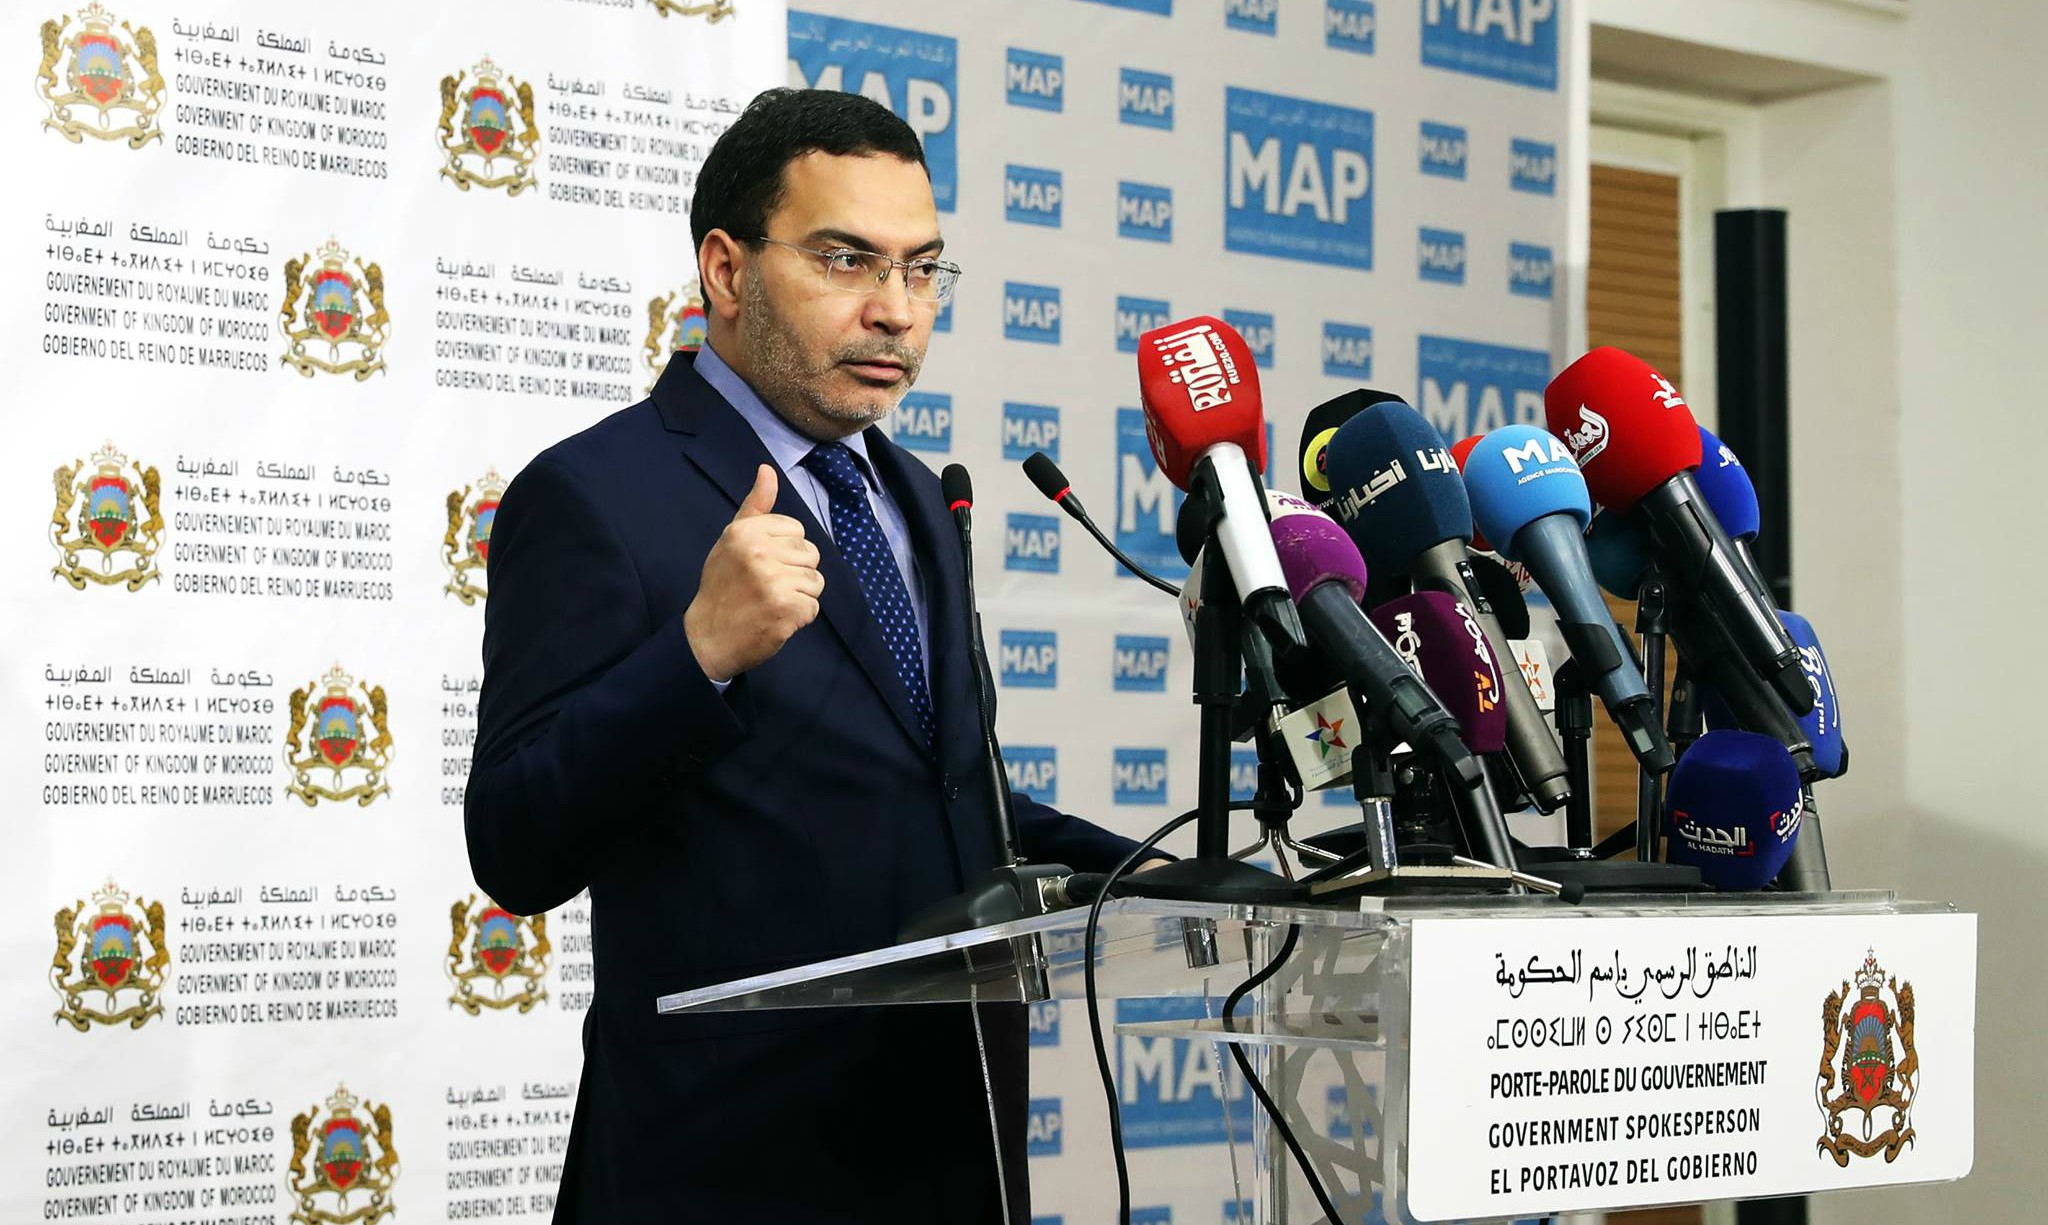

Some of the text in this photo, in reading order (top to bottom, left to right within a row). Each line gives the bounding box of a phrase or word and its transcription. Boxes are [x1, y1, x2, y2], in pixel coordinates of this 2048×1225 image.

[1327, 11, 1374, 42] MAP
[1007, 58, 1063, 97] MAP
[176, 74, 385, 120] GOUVERNEMENT DU ROYAUME DU MAROC
[1120, 82, 1173, 115] MAP
[177, 104, 386, 150] GOVERNMENT OF KINGDOM OF MOROCCO
[176, 134, 387, 179] GOBIERNO DEL REINO DE MARRUECOS
[1005, 177, 1061, 213] MAP
[1230, 131, 1369, 225] MAP
[1119, 196, 1172, 228] MAP
[47, 271, 268, 311] GOUVERNEMENT DU ROYAUME DU MAROC
[45, 302, 268, 342] GOVERNMENT OF KINGDOM OF MOROCCO
[1004, 296, 1060, 329] MAP
[43, 334, 267, 372] GOBIERNO DEL REINO DE MARRUECOS
[1207, 331, 1241, 385] RUE20.COM
[1323, 338, 1371, 367] MAP
[893, 404, 951, 440] MAP
[1003, 418, 1059, 450] MAP
[1502, 437, 1579, 475] MA
[175, 512, 390, 541] GOUVERNEMENT DU ROYAUME DU MAROC
[175, 543, 392, 571] GOVERNMENT OF KINGDOM OF MOROCCO
[1006, 529, 1059, 562] MAP
[175, 573, 392, 600] GOBIERNO DEL REINO DE MARRUECOS
[1002, 644, 1056, 678] MAP
[1114, 648, 1168, 680] MAP
[1474, 670, 1494, 713] TV
[46, 722, 272, 744] GOUVERNEMENT DU ROYAUME DU MAROC
[45, 754, 273, 774] GOVERNMENT OF KINGDOM OF MOROCCO
[1114, 763, 1166, 795] MAP
[43, 785, 272, 805] GOBIERNO DEL REINO DE MARRUECOS
[1678, 820, 1746, 848] الحدث
[1687, 841, 1734, 856] AL HADATH
[1495, 945, 1757, 1005] الناطق الرسمي باسم الحكومة
[1490, 1060, 1768, 1099] PORTE-PAROLE DU GOUVERNEMENT
[1488, 1107, 1760, 1149] GOVERNMENT SPOKESPERSON
[47, 1154, 274, 1187] GOUVERNEMENT DU ROYAUME DU MAROC
[1490, 1150, 1758, 1195] EL PORTAVOZ DEL GOBIERNO
[44, 1194, 117, 1219] GOVERNMENT
[124, 1193, 138, 1213] OF
[144, 1190, 195, 1211] KINGDOM
[201, 1188, 215, 1208] OF
[220, 1184, 276, 1206] MOROCCO
